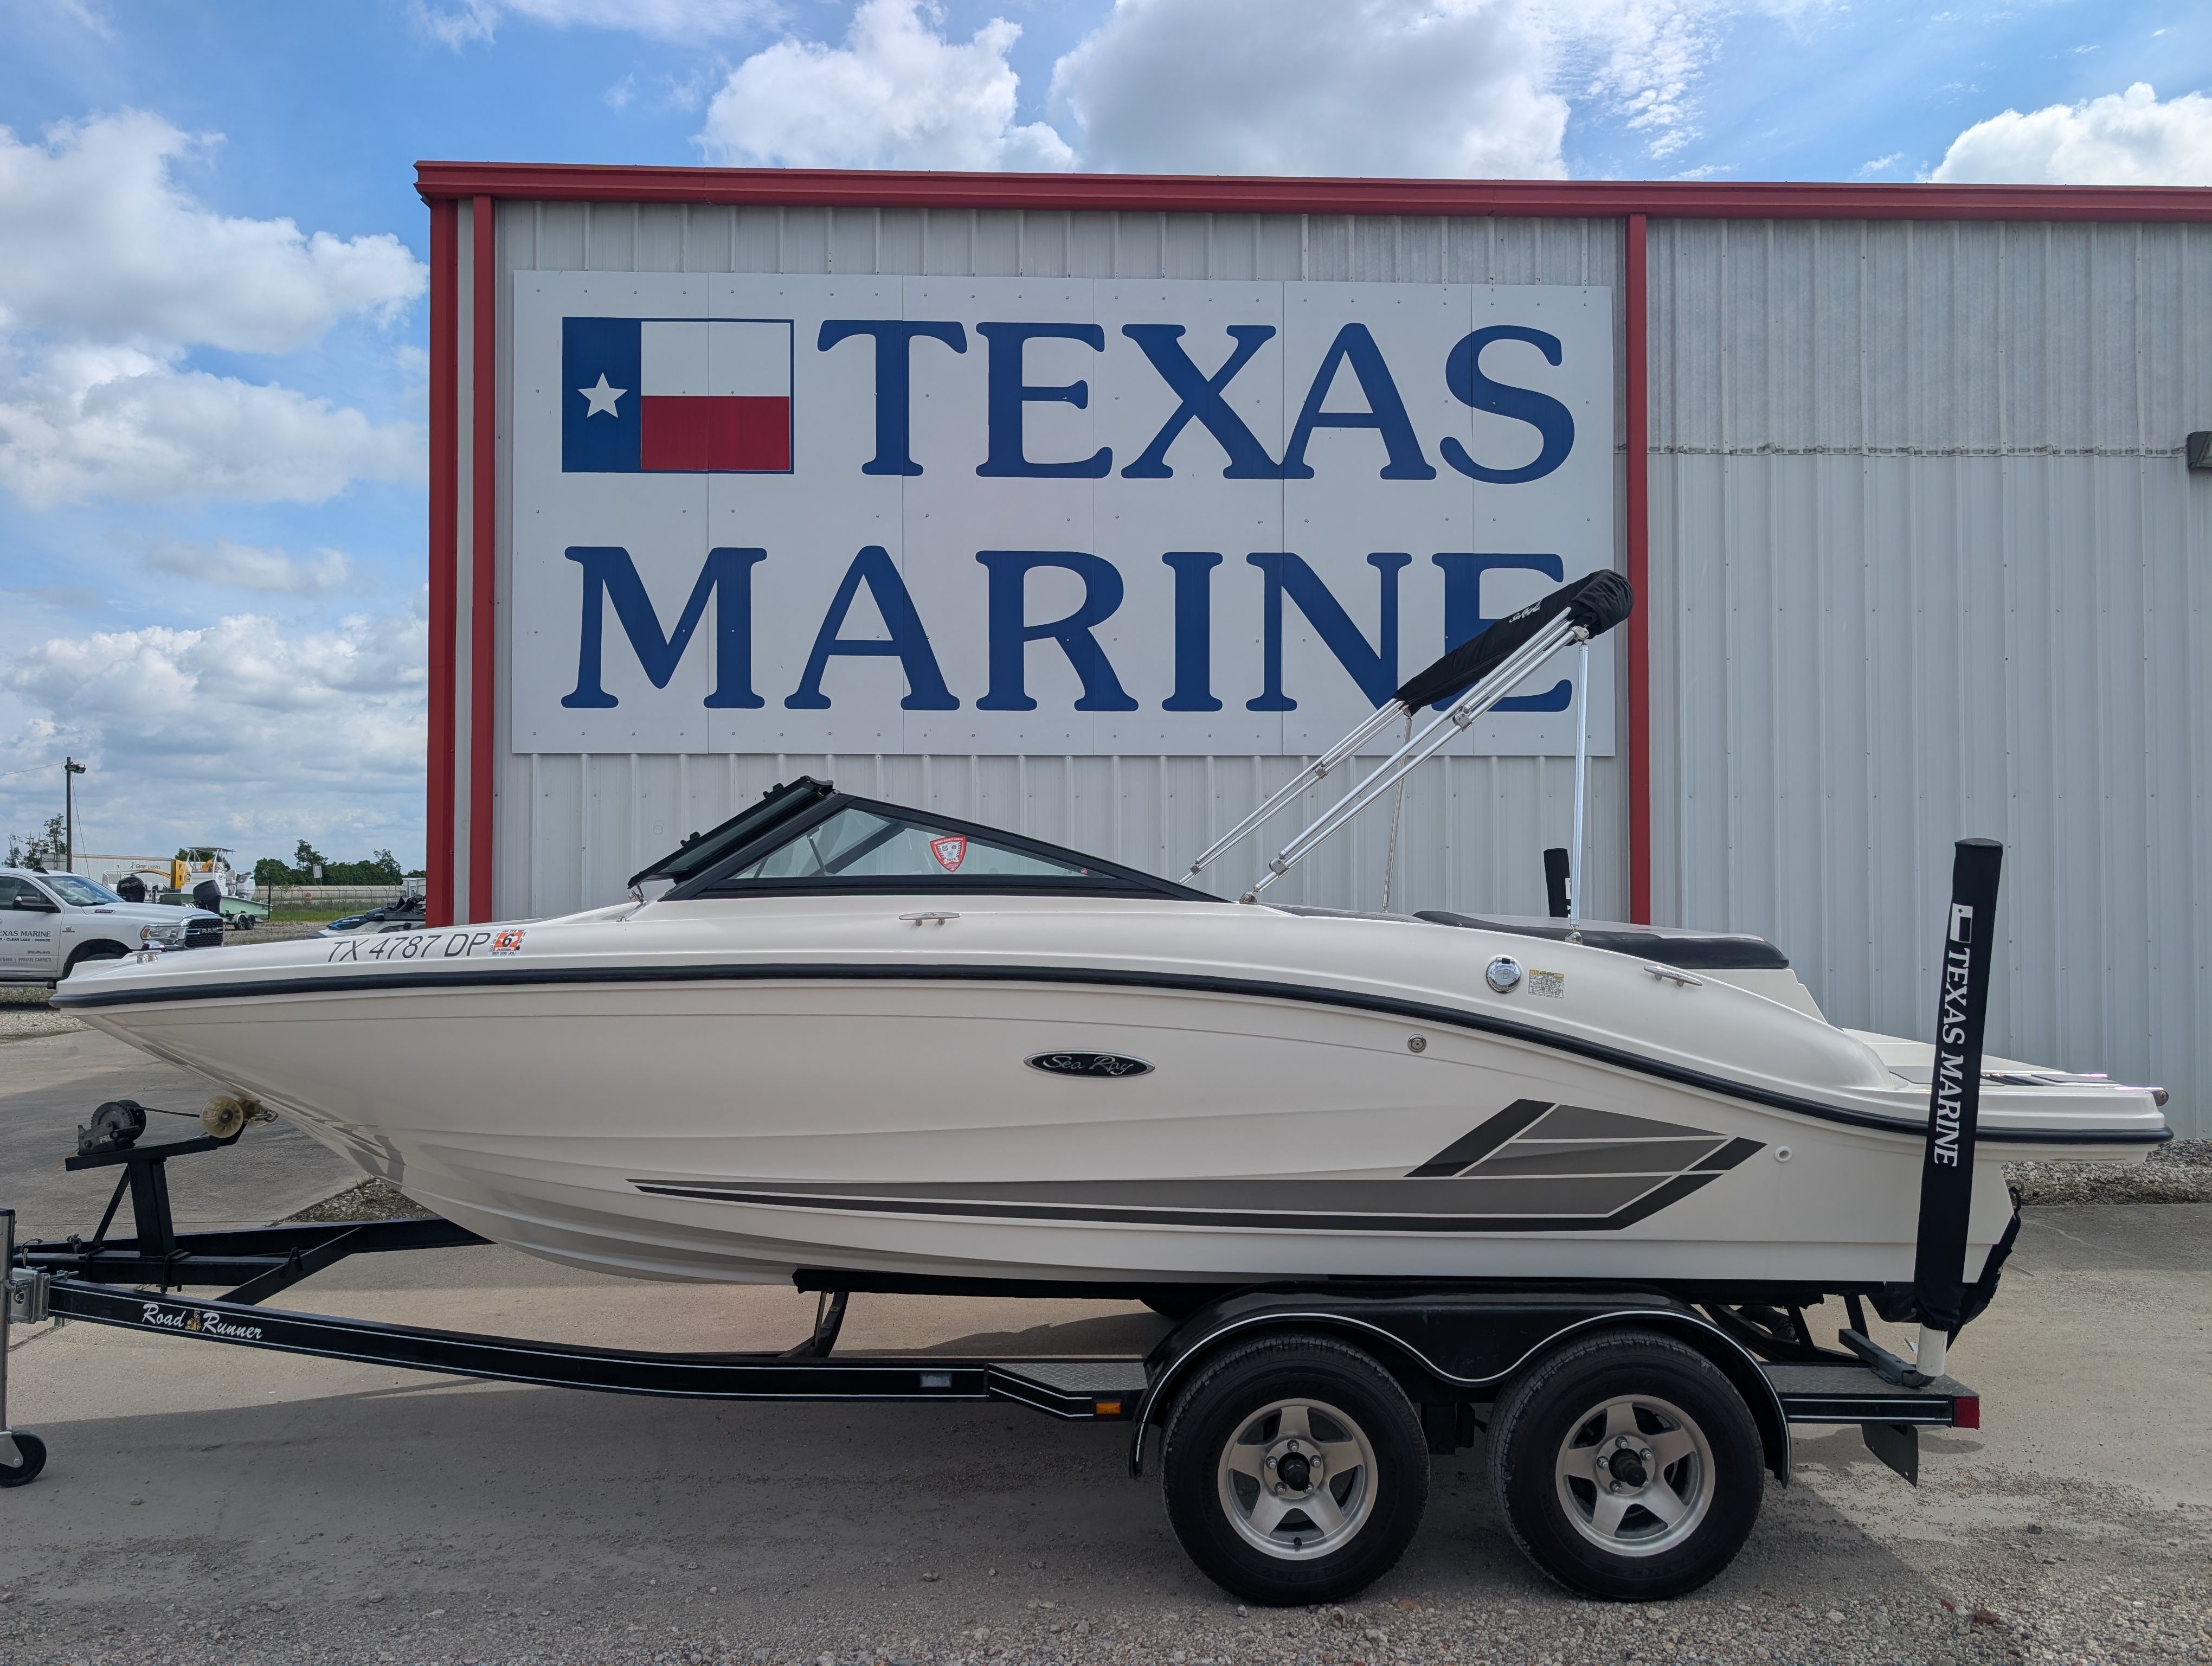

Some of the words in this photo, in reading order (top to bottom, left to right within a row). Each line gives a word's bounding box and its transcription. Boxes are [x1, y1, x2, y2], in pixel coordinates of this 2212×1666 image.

[818, 319, 1575, 484] TEXAS
[561, 545, 1572, 714] MARINE
[327, 940, 370, 963] TX
[369, 934, 443, 960] 4787
[443, 932, 491, 957] DP
[502, 933, 515, 947] 6
[1943, 947, 1970, 1045] TEXAS
[1043, 1055, 1085, 1069] Sea
[1089, 1055, 1134, 1075] Ray
[1934, 1050, 1964, 1168] MARINE
[142, 1303, 186, 1328] Road
[201, 1312, 263, 1340] Runner
